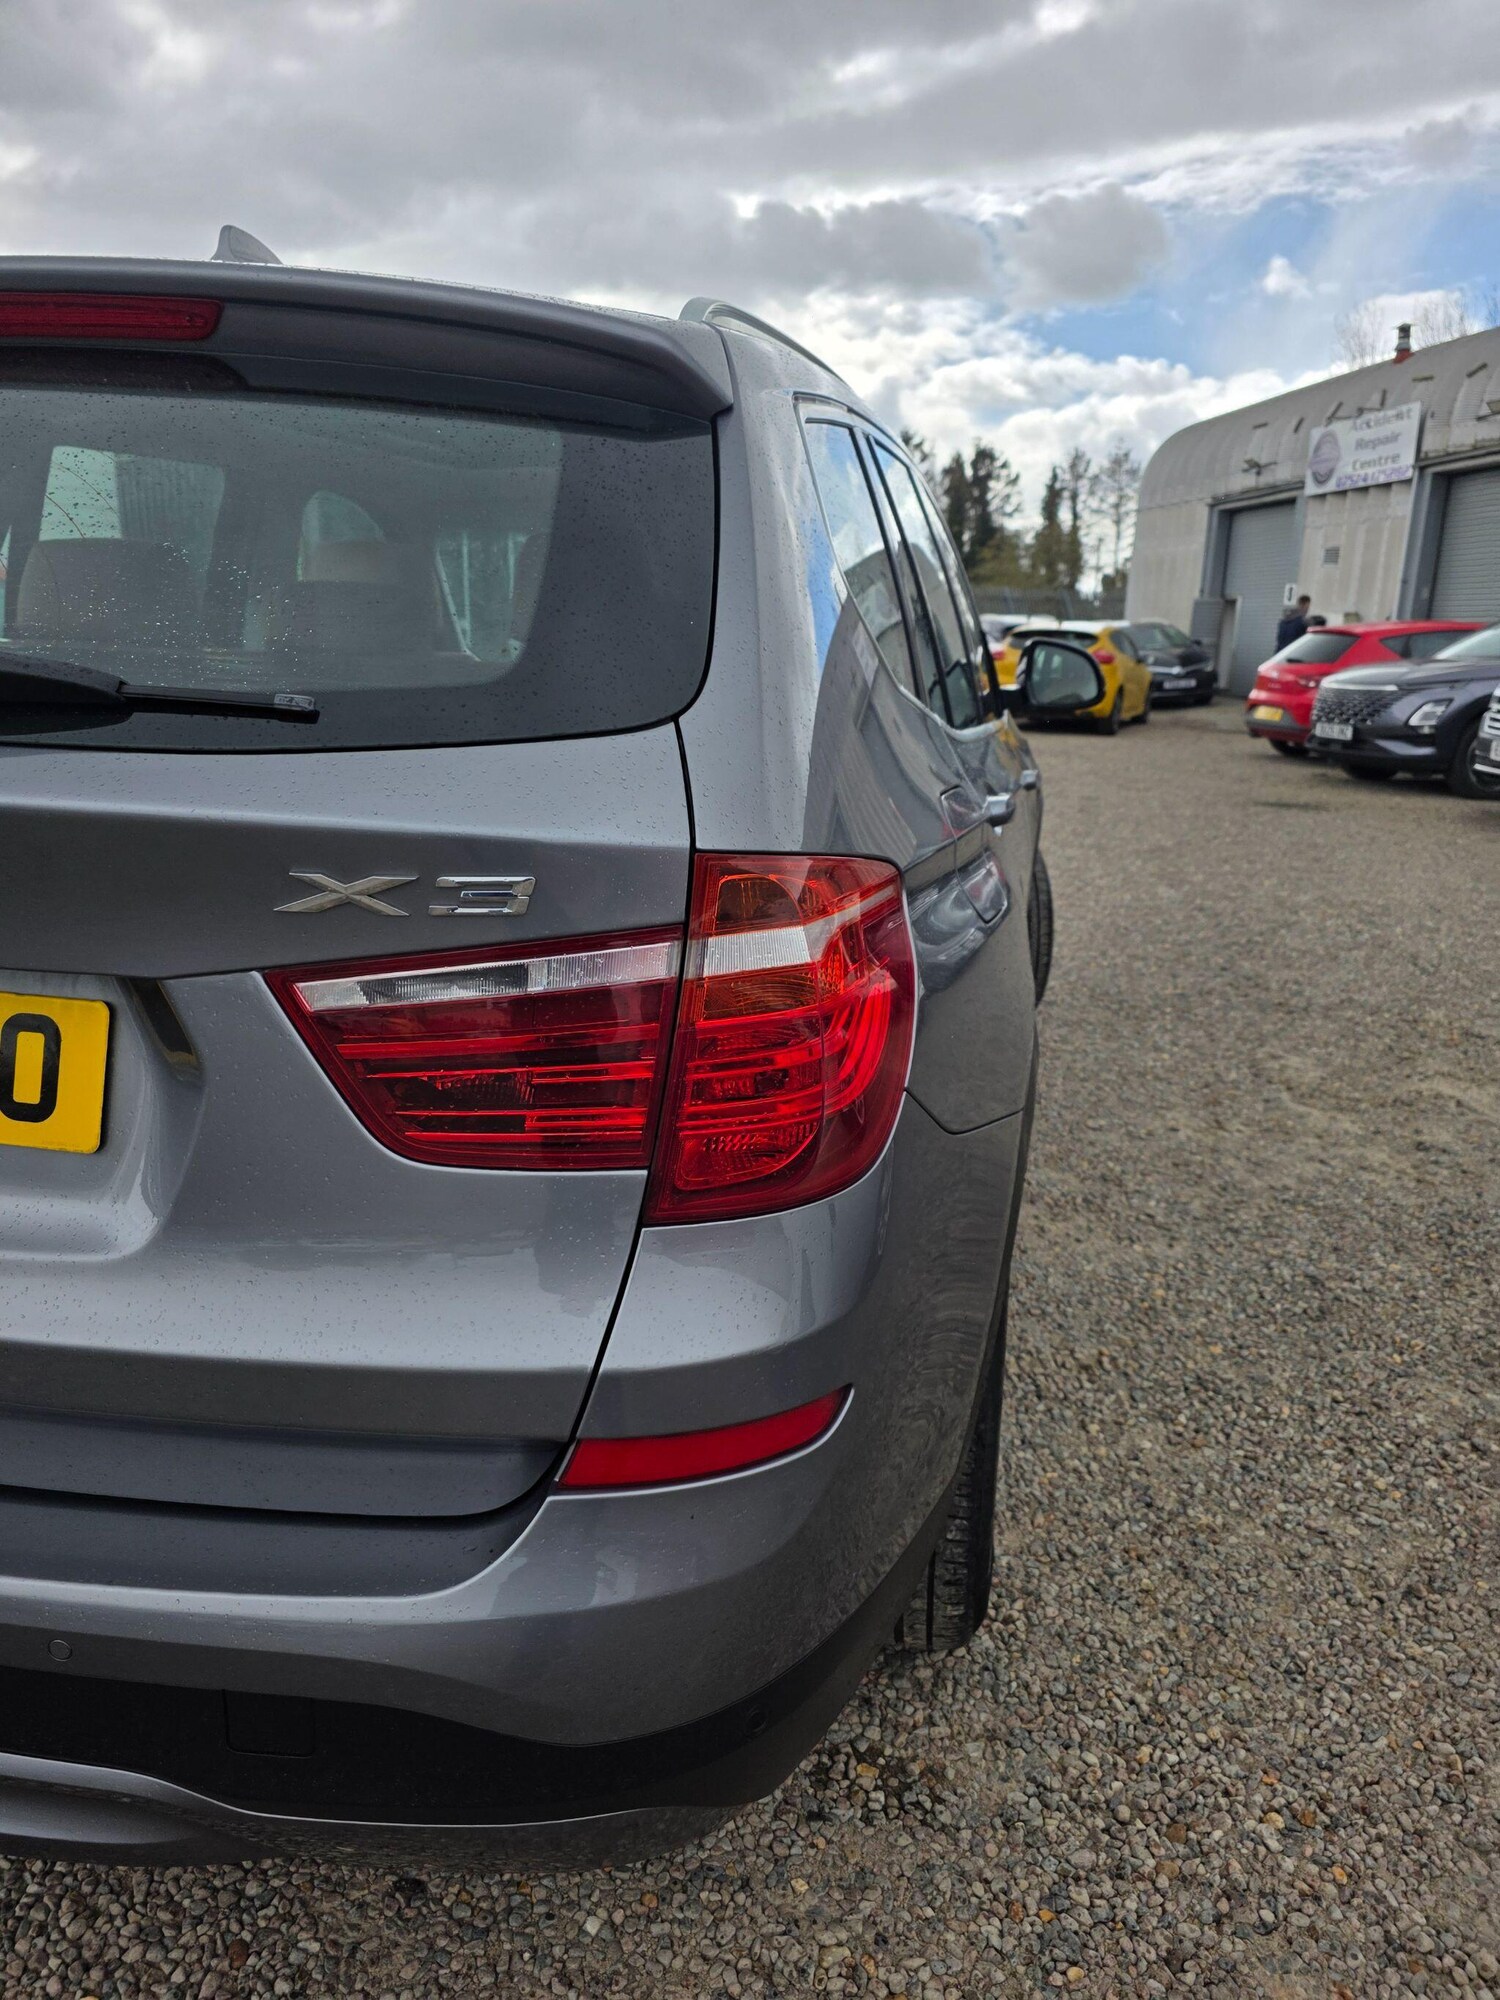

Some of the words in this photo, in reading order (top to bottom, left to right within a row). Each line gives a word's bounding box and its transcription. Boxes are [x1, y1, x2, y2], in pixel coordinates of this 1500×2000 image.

[1353, 407, 1412, 432] Accident
[1355, 431, 1402, 451] Repair
[1352, 453, 1400, 472] Centre
[273, 871, 537, 917] X3
